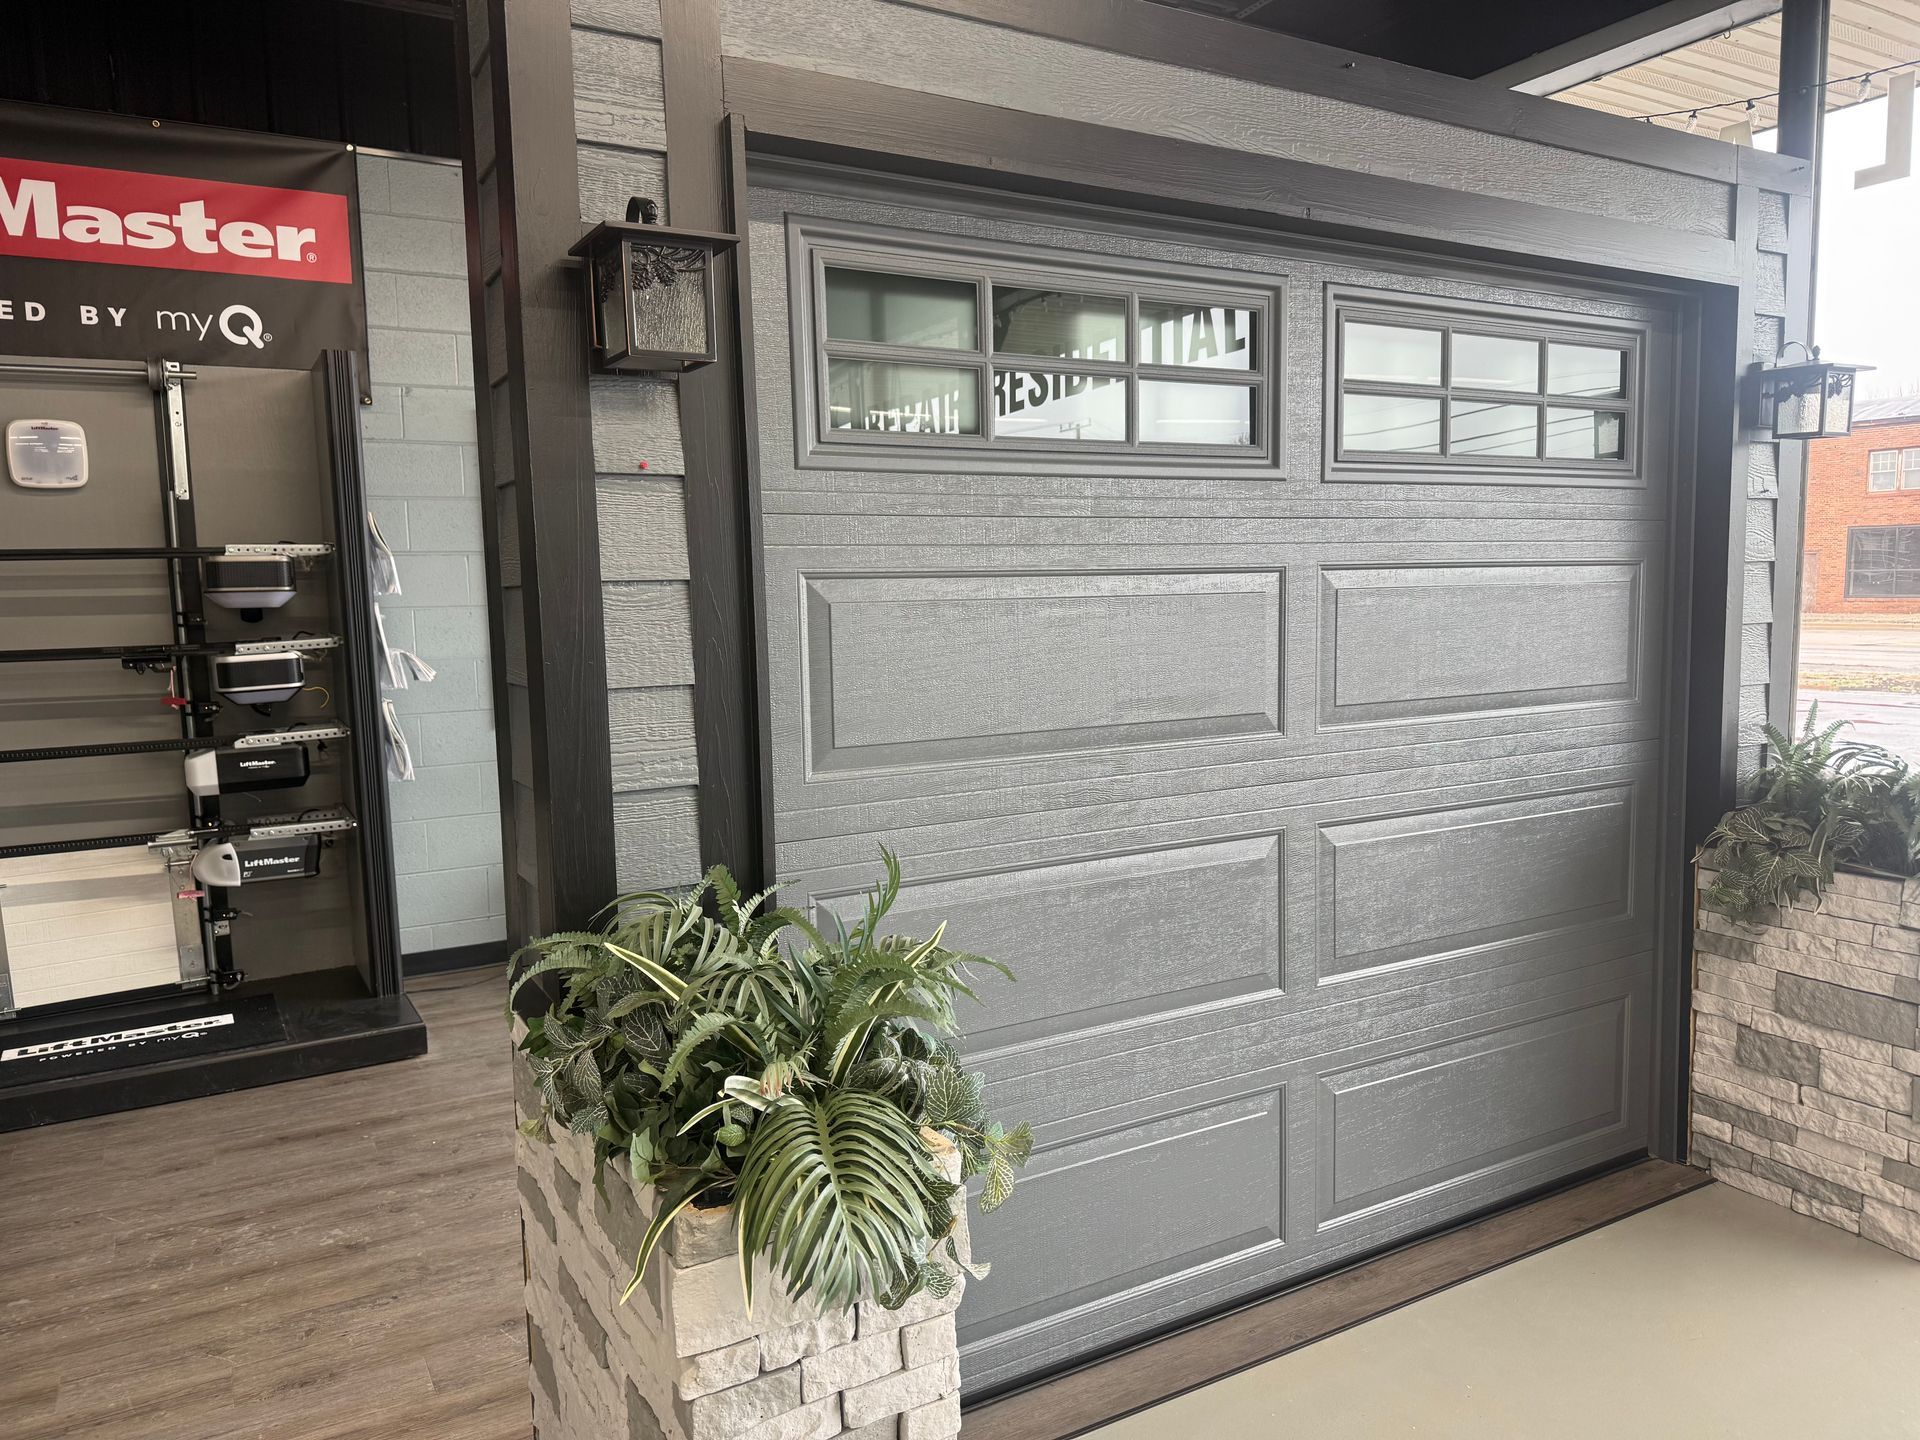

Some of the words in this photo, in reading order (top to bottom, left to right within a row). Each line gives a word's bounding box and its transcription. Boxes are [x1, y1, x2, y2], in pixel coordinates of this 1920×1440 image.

[79, 305, 127, 327] BY
[156, 304, 265, 349] myQ
[244, 857, 300, 867] LiftMaster
[17, 1019, 220, 1056] LiftMaster
